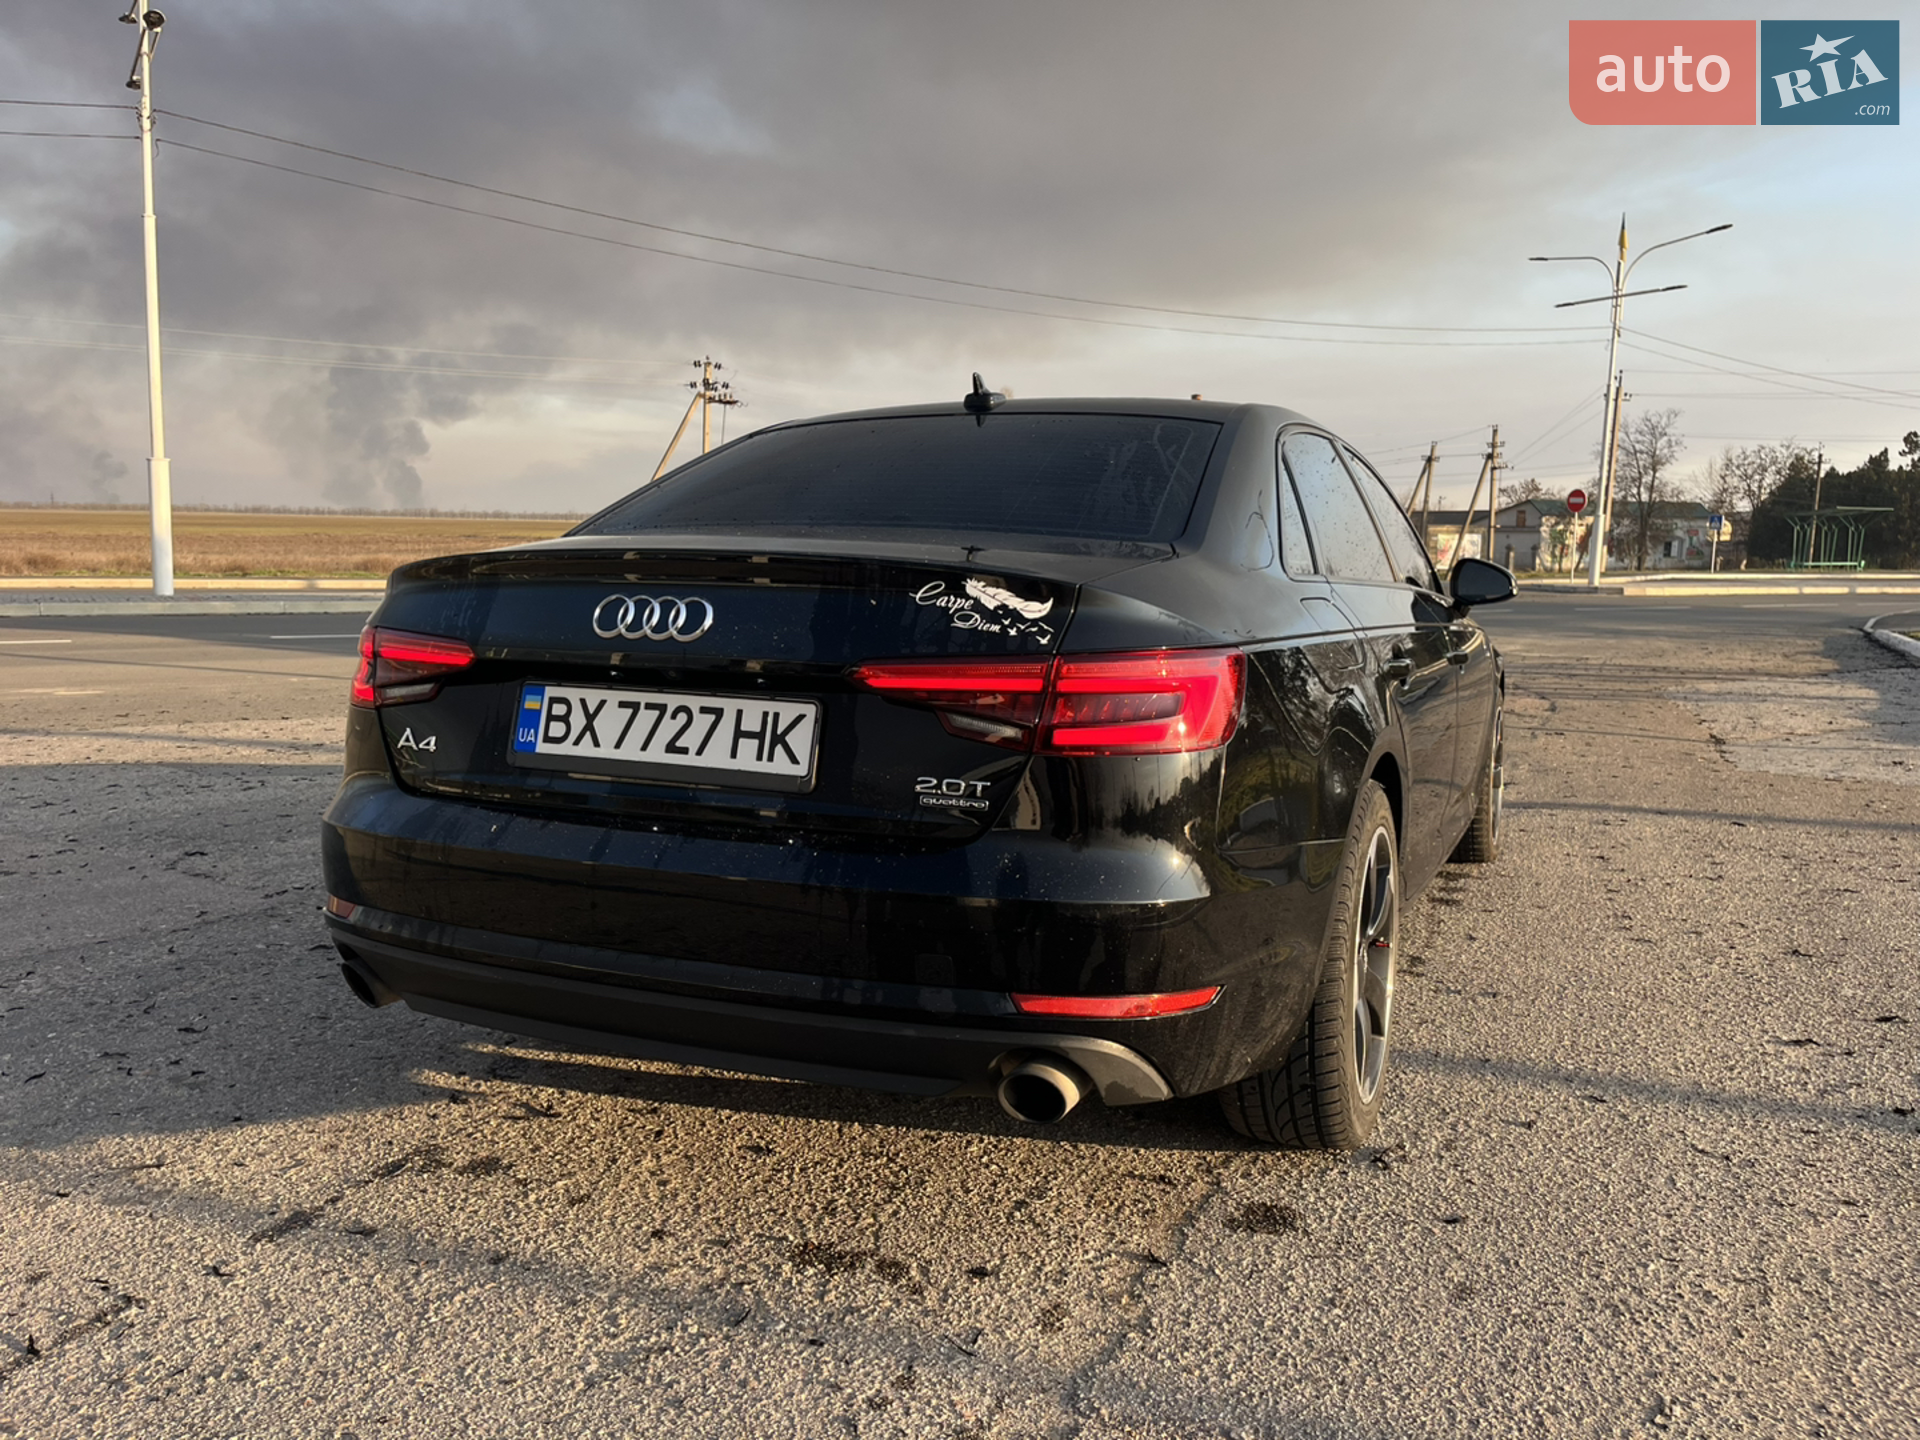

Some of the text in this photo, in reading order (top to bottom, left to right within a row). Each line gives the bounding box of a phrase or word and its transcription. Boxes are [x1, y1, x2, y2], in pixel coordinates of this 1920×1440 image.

[909, 581, 974, 614] Carpe
[951, 611, 1001, 632] Diem
[518, 727, 536, 743] UA
[614, 701, 724, 756] 7727
[397, 727, 437, 752] A4
[915, 777, 991, 797] 2.0T
[922, 797, 985, 809] quattro
